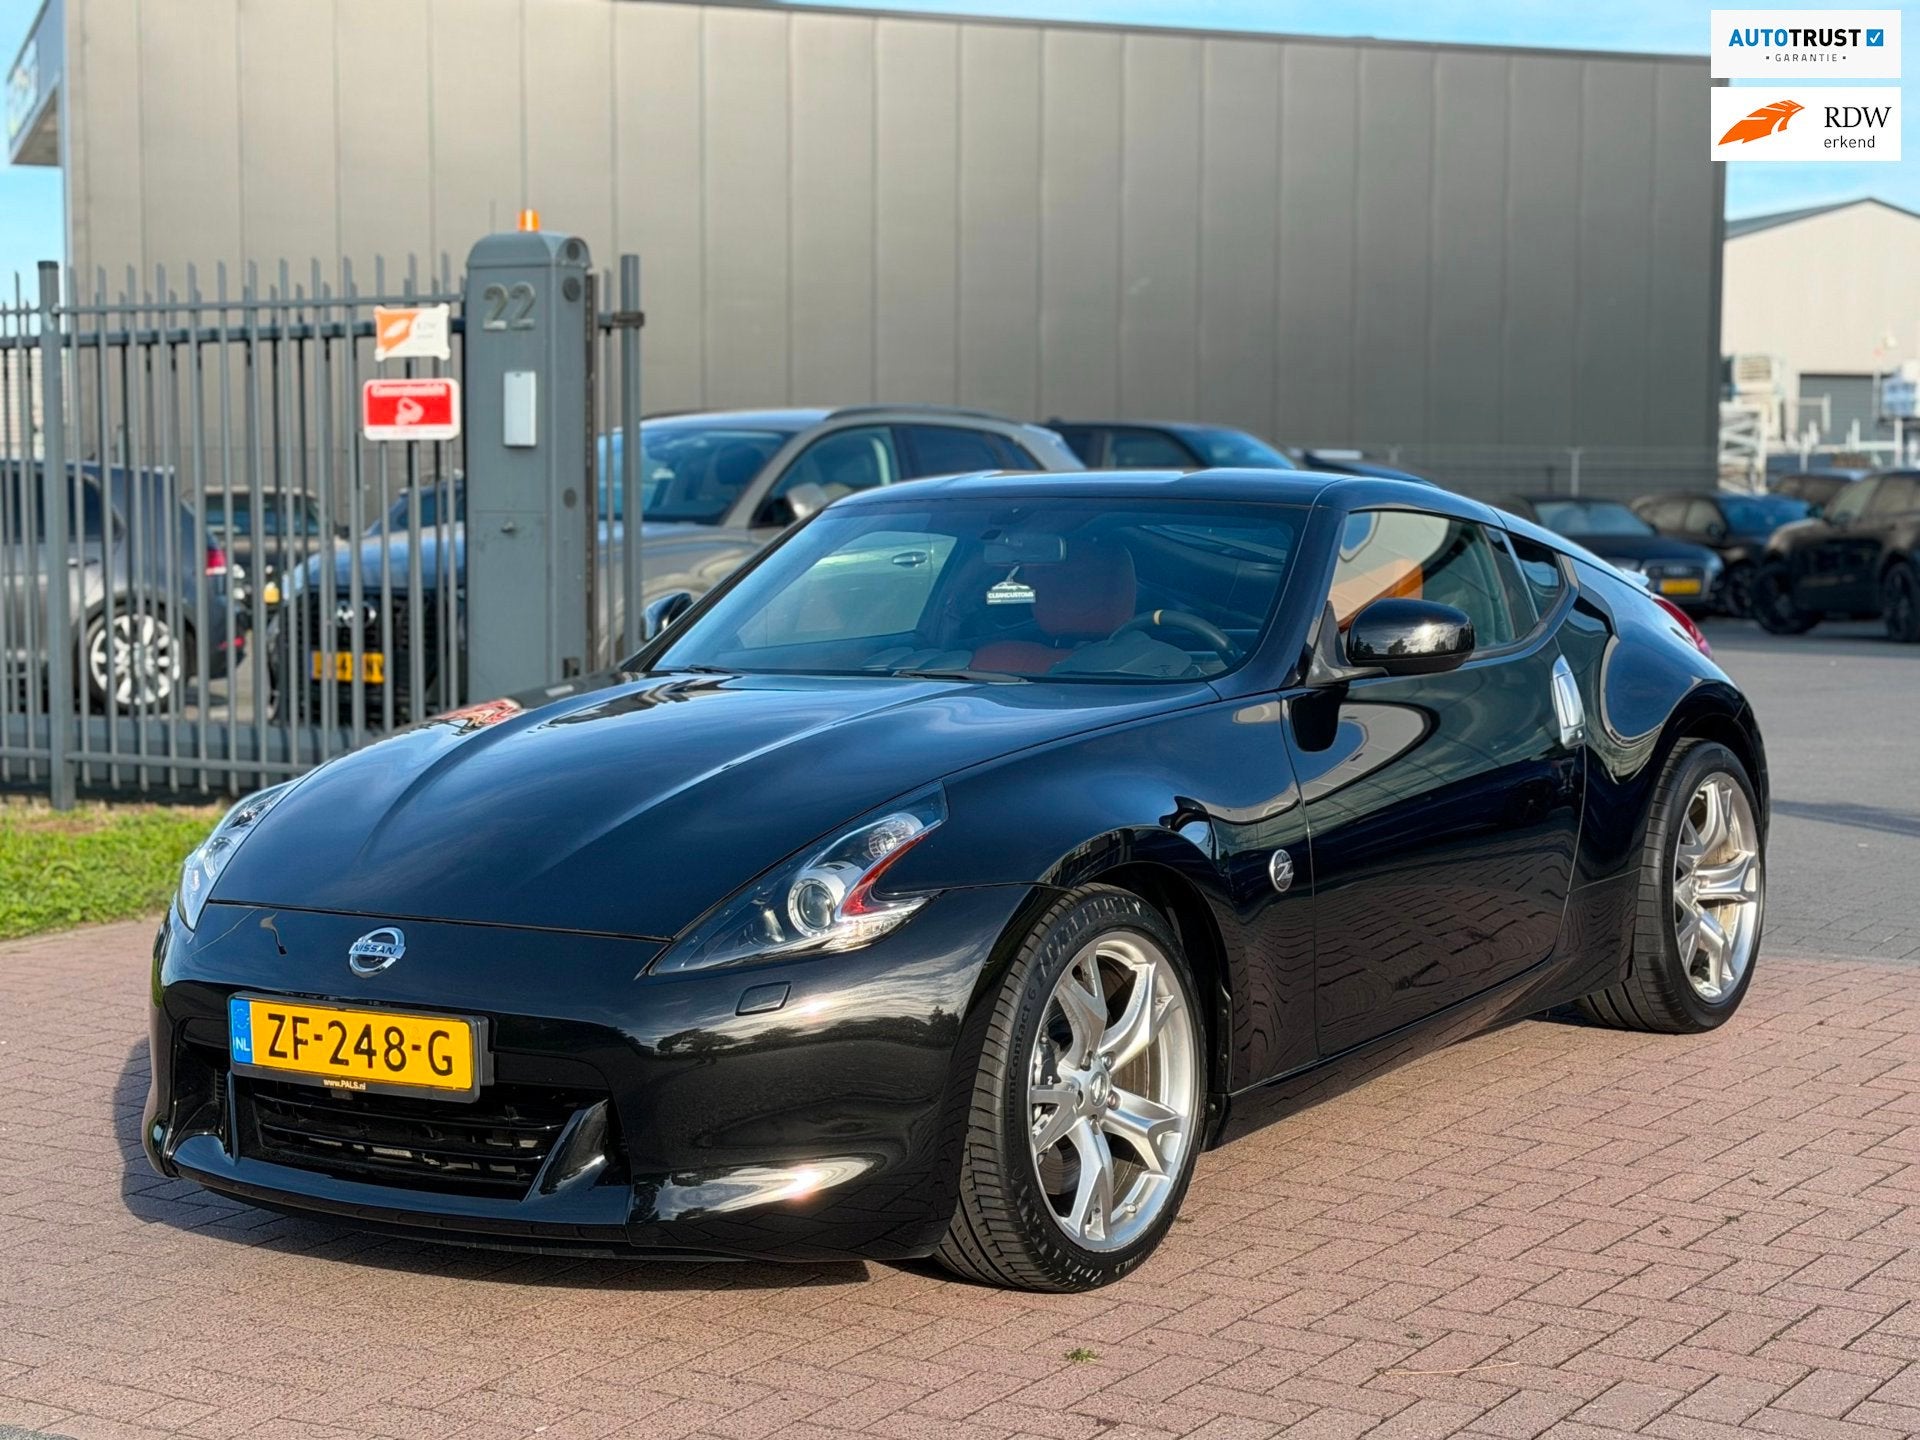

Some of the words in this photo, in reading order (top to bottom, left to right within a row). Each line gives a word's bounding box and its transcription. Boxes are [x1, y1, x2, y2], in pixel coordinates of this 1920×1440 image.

[483, 281, 537, 331] 22
[353, 943, 397, 955] NISSAN
[233, 1036, 250, 1052] NL
[267, 1013, 453, 1077] ZF-248-G
[323, 1079, 366, 1090] www.PALS.nl
